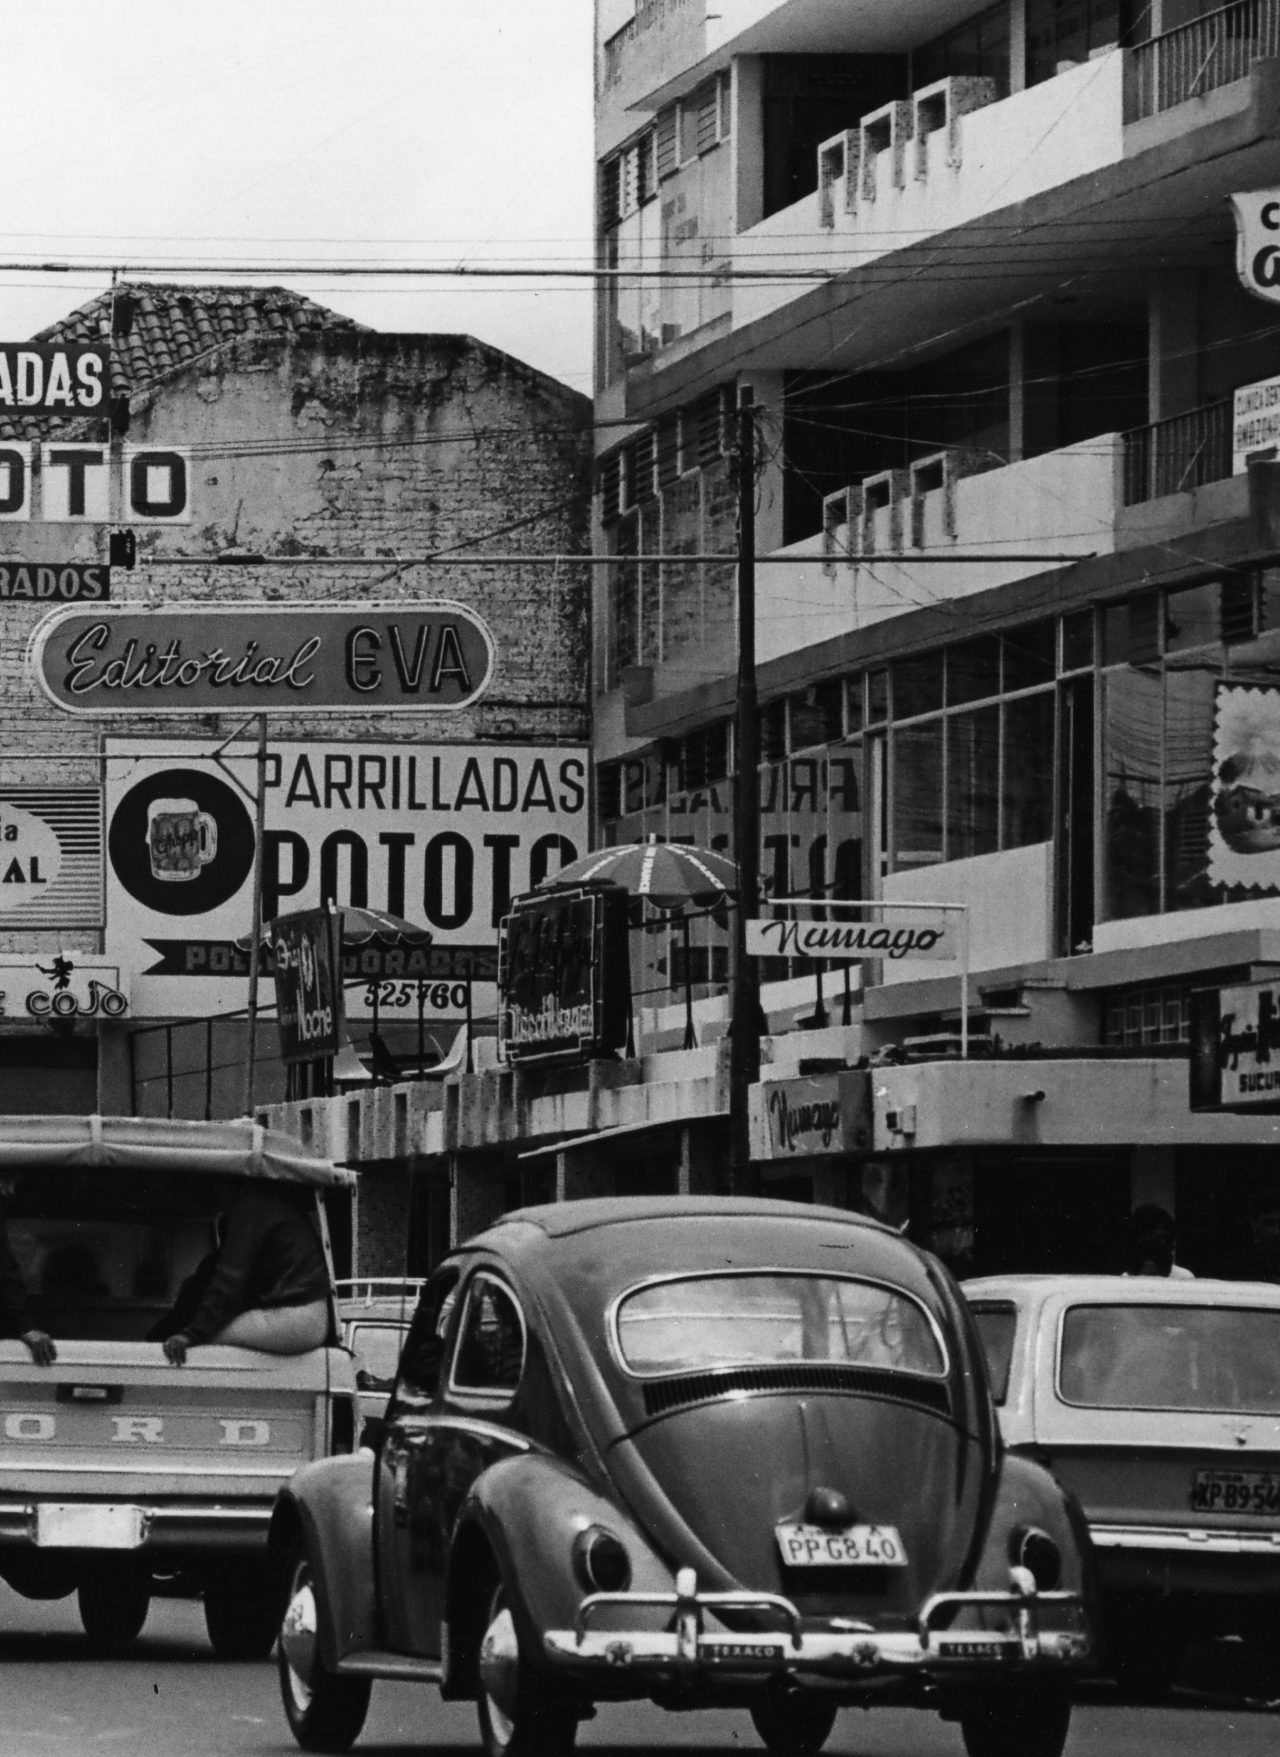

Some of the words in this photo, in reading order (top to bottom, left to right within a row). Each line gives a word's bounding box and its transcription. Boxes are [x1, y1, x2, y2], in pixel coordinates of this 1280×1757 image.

[63, 622, 321, 693] Editorial
[345, 624, 473, 693] EVA
[261, 753, 585, 814] PARRILLADAS
[26, 980, 128, 1016] COJO
